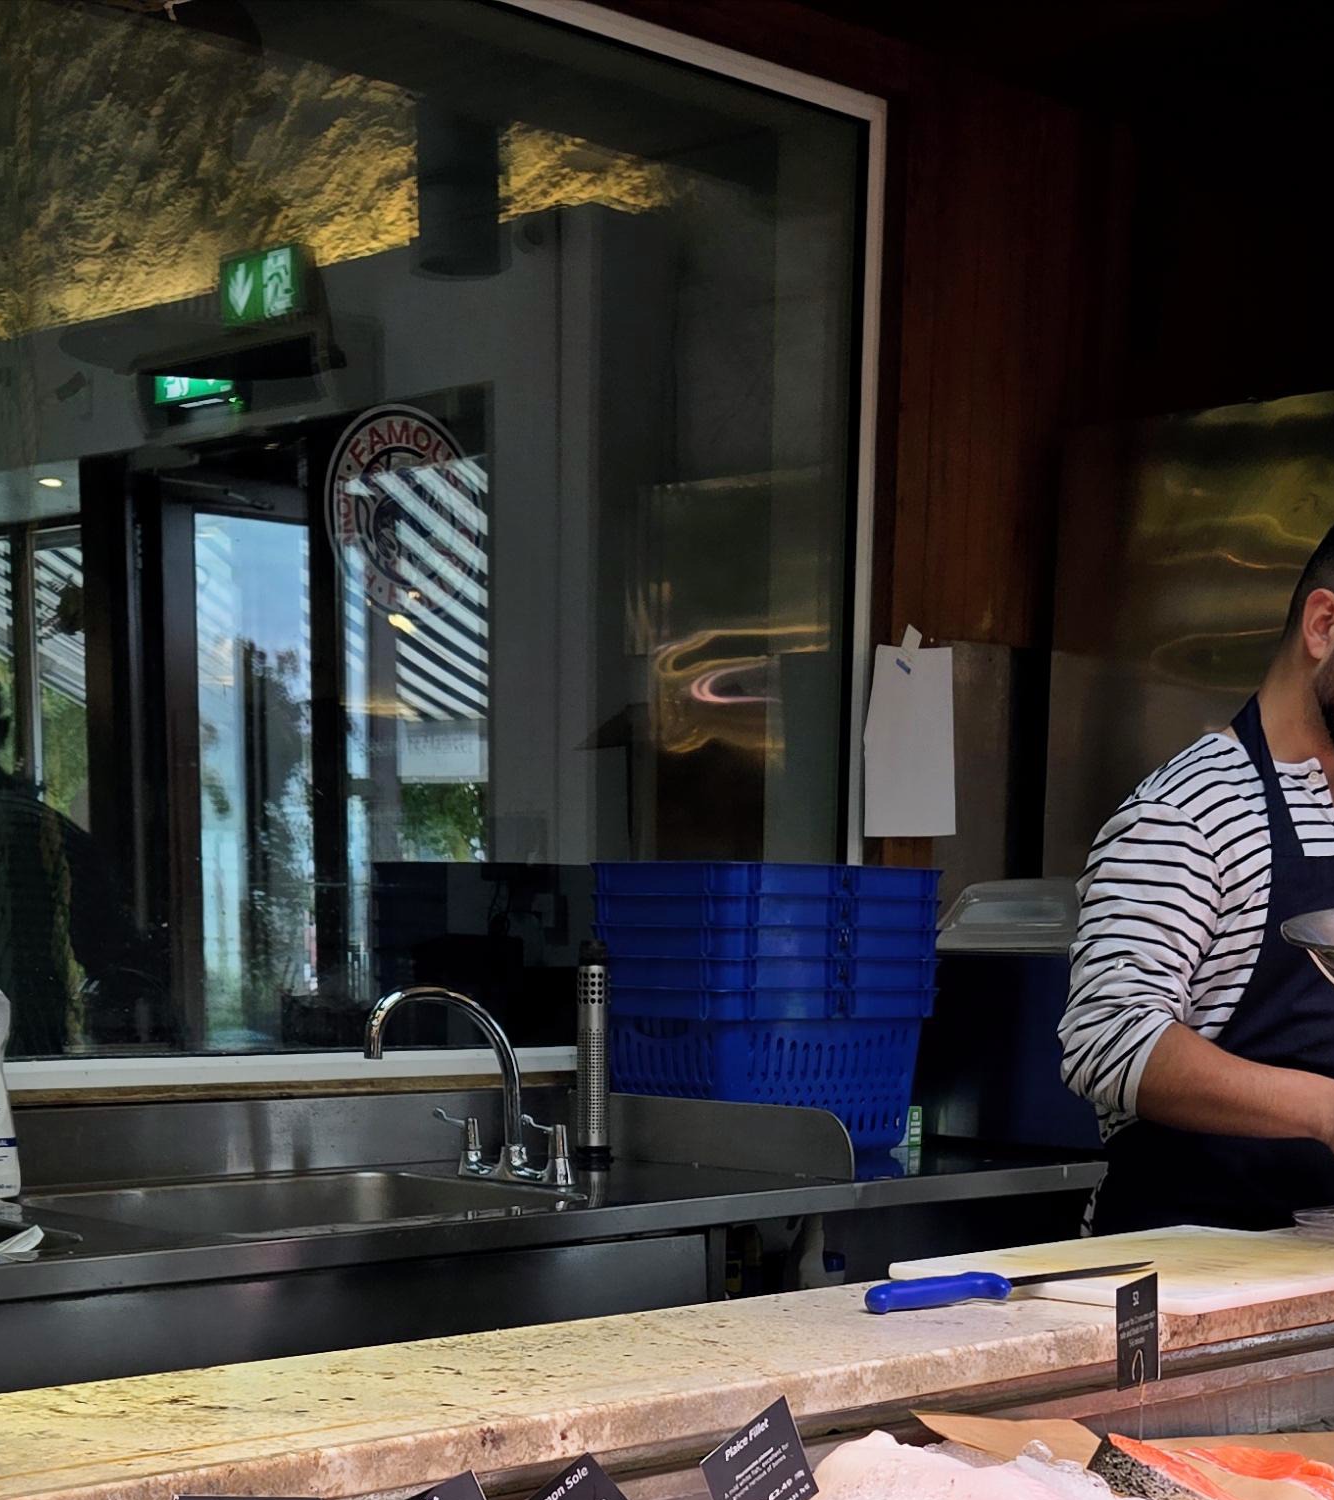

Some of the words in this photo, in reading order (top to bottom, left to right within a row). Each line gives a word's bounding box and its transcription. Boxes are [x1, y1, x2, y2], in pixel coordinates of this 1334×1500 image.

[724, 1436, 749, 1462] Plaice
[749, 1418, 769, 1442] Fillet
[565, 1466, 589, 1490] Sole
